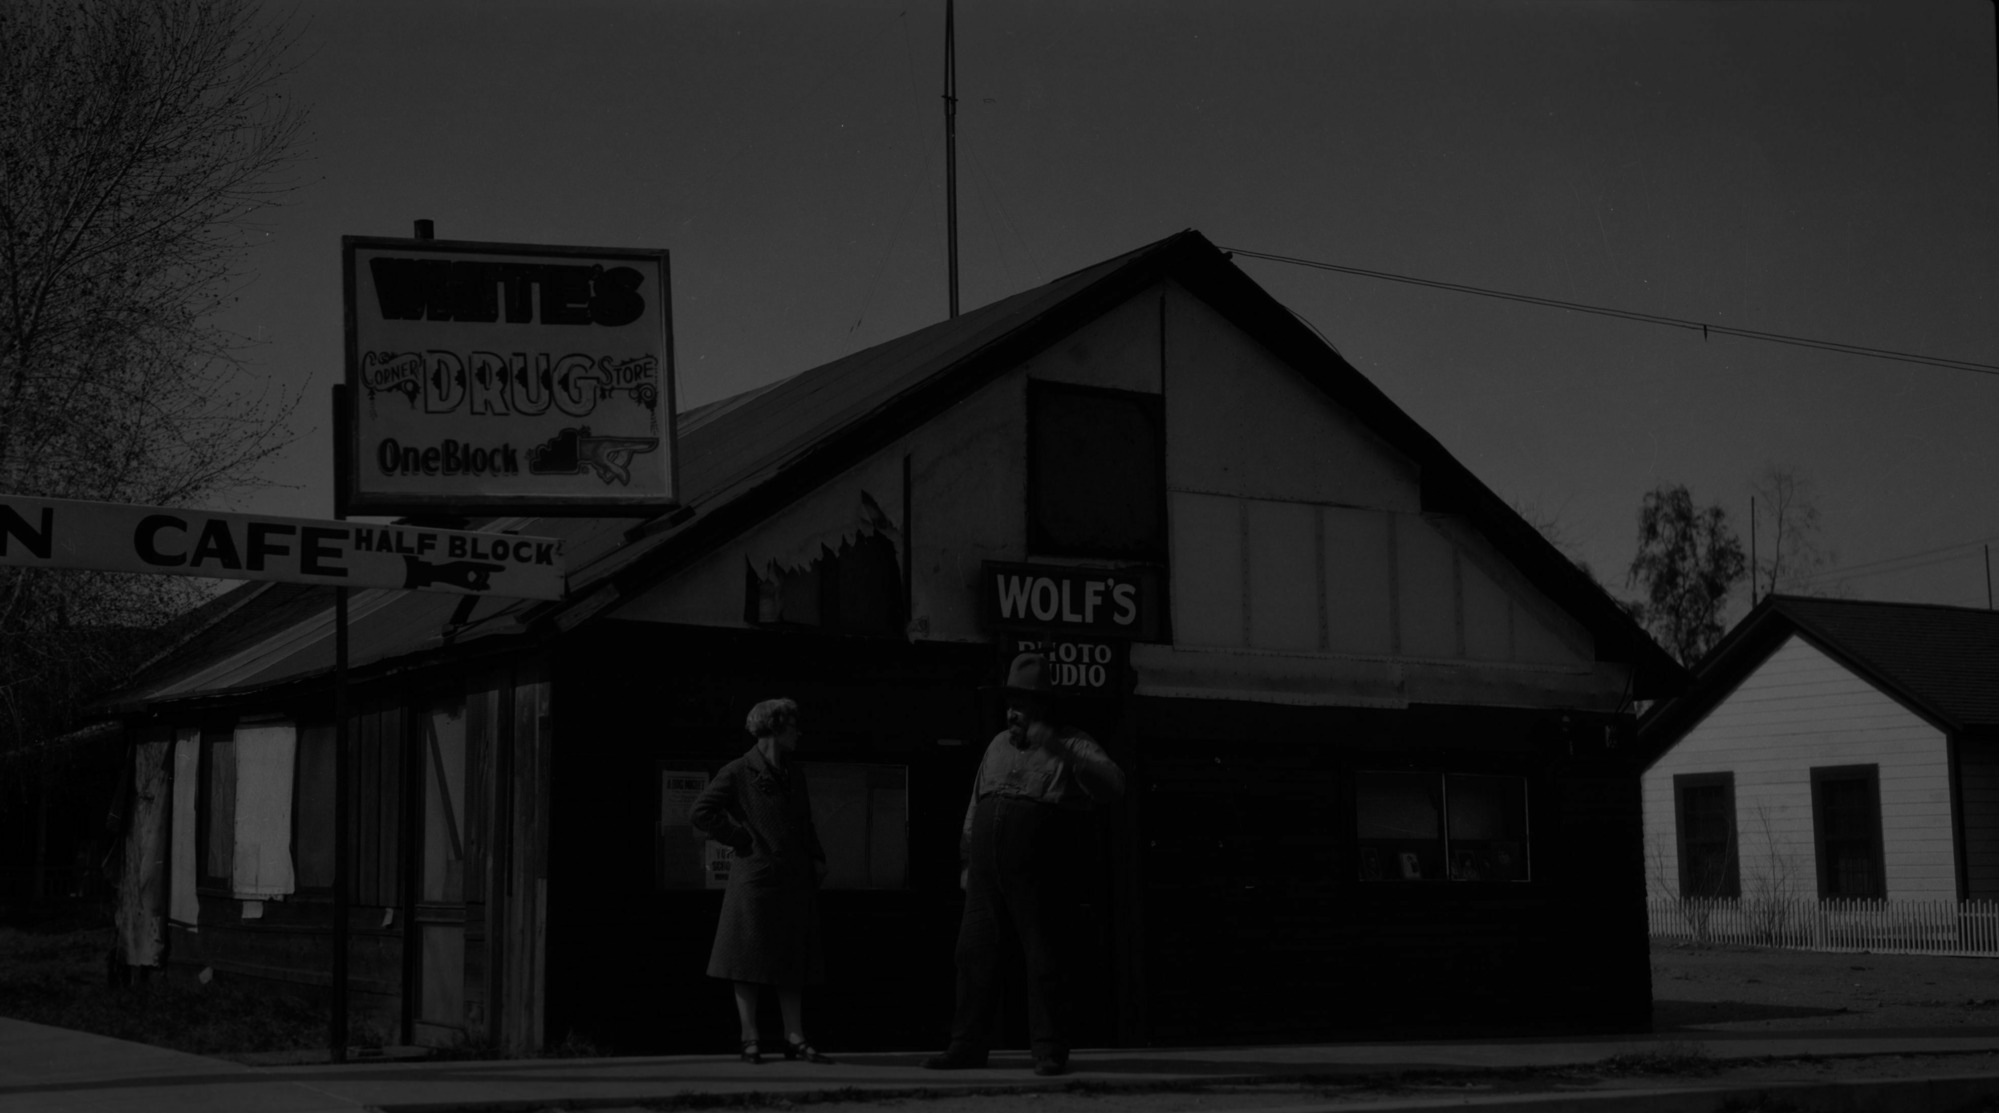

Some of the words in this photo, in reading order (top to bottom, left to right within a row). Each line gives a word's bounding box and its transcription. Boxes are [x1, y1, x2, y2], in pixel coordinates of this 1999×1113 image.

[369, 257, 645, 326] WHITE'S
[424, 349, 602, 418] DRUG
[599, 355, 654, 389] STORE
[134, 514, 350, 577] CAFE
[355, 528, 438, 556] HALF
[448, 534, 555, 566] BLOCK
[996, 574, 1137, 626] WOLF'S
[1049, 664, 1107, 688] UDIO
